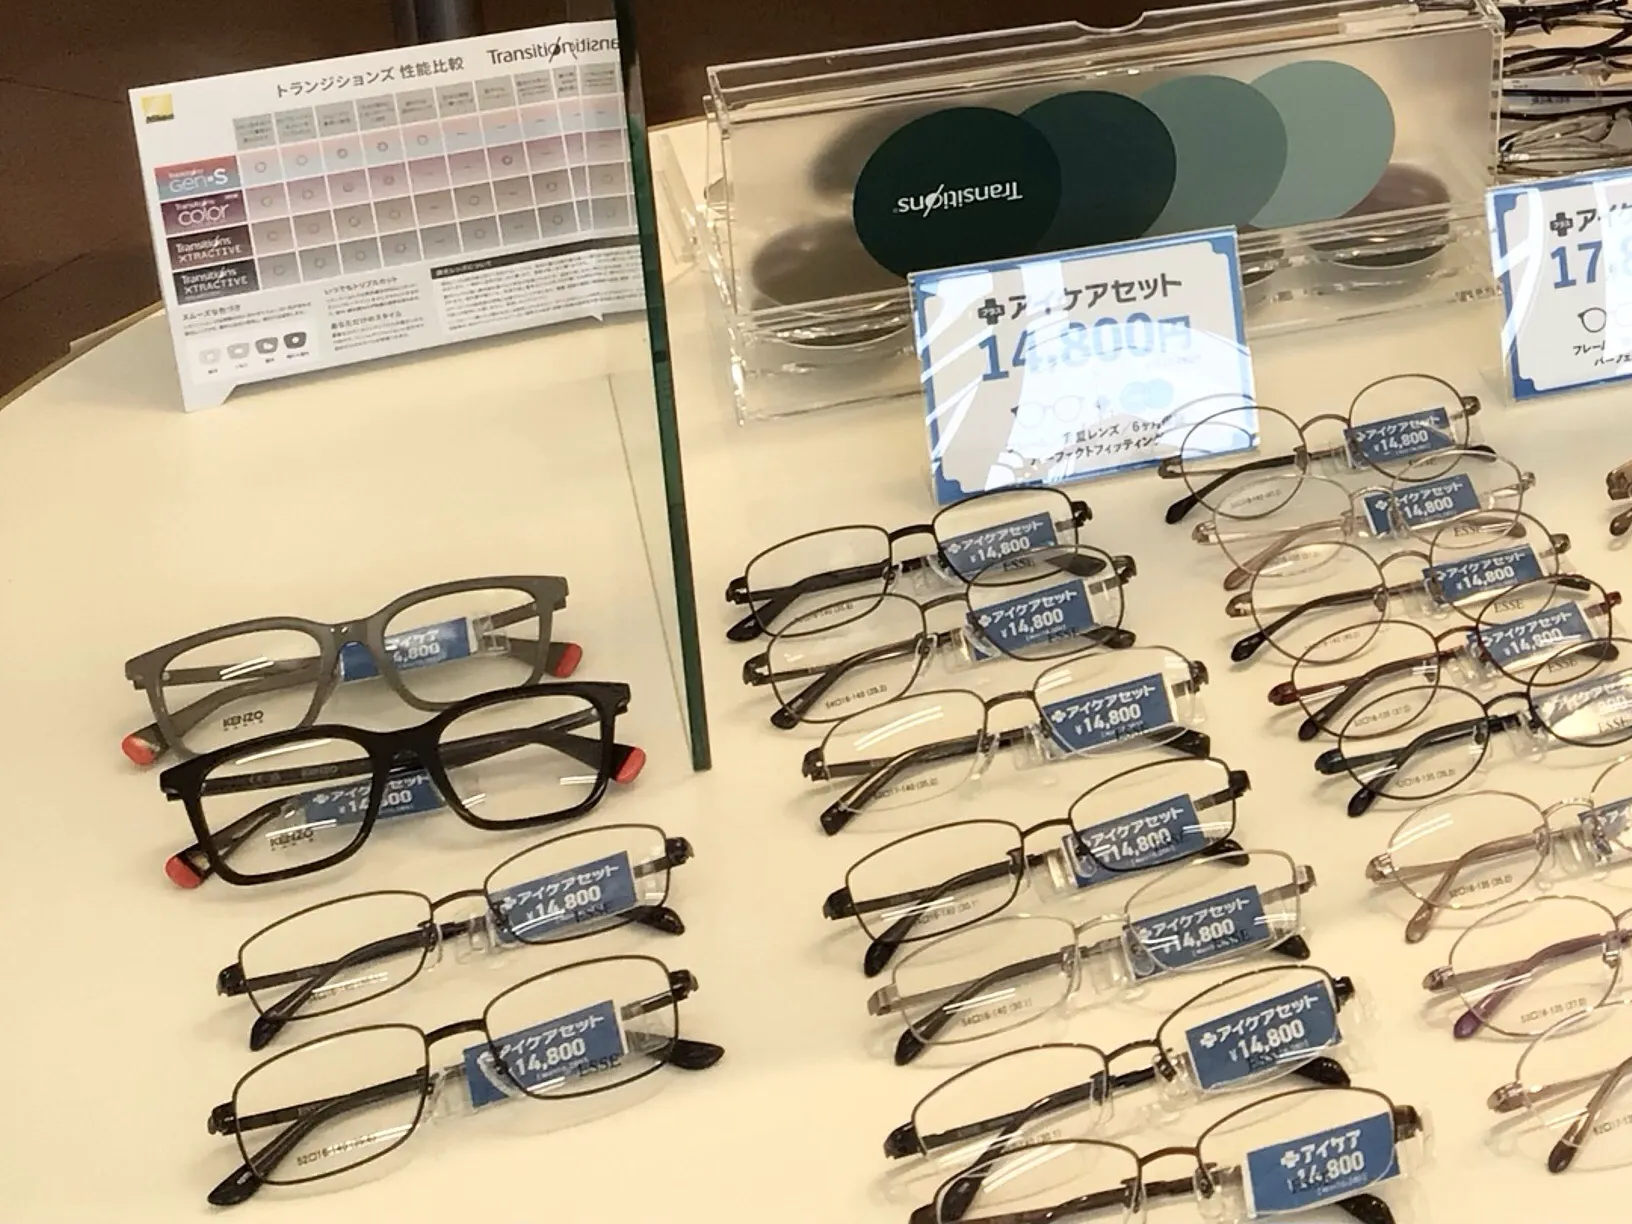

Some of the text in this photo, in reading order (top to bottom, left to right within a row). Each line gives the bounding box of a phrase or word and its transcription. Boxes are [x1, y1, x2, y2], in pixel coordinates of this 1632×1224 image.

[275, 56, 465, 98] トランジションズ 性能比較
[961, 520, 1045, 550] アイケアセット
[991, 589, 1078, 621] アイケアセット
[1000, 607, 1064, 640] ¥14,800
[1066, 681, 1156, 716] アイケアセット
[1074, 703, 1141, 736] ¥14,800
[517, 864, 619, 906] アイケアセット
[1215, 991, 1320, 1043] アイケアセット
[1228, 1018, 1305, 1062] ¥14,800
[1298, 1129, 1362, 1162] アイケア
